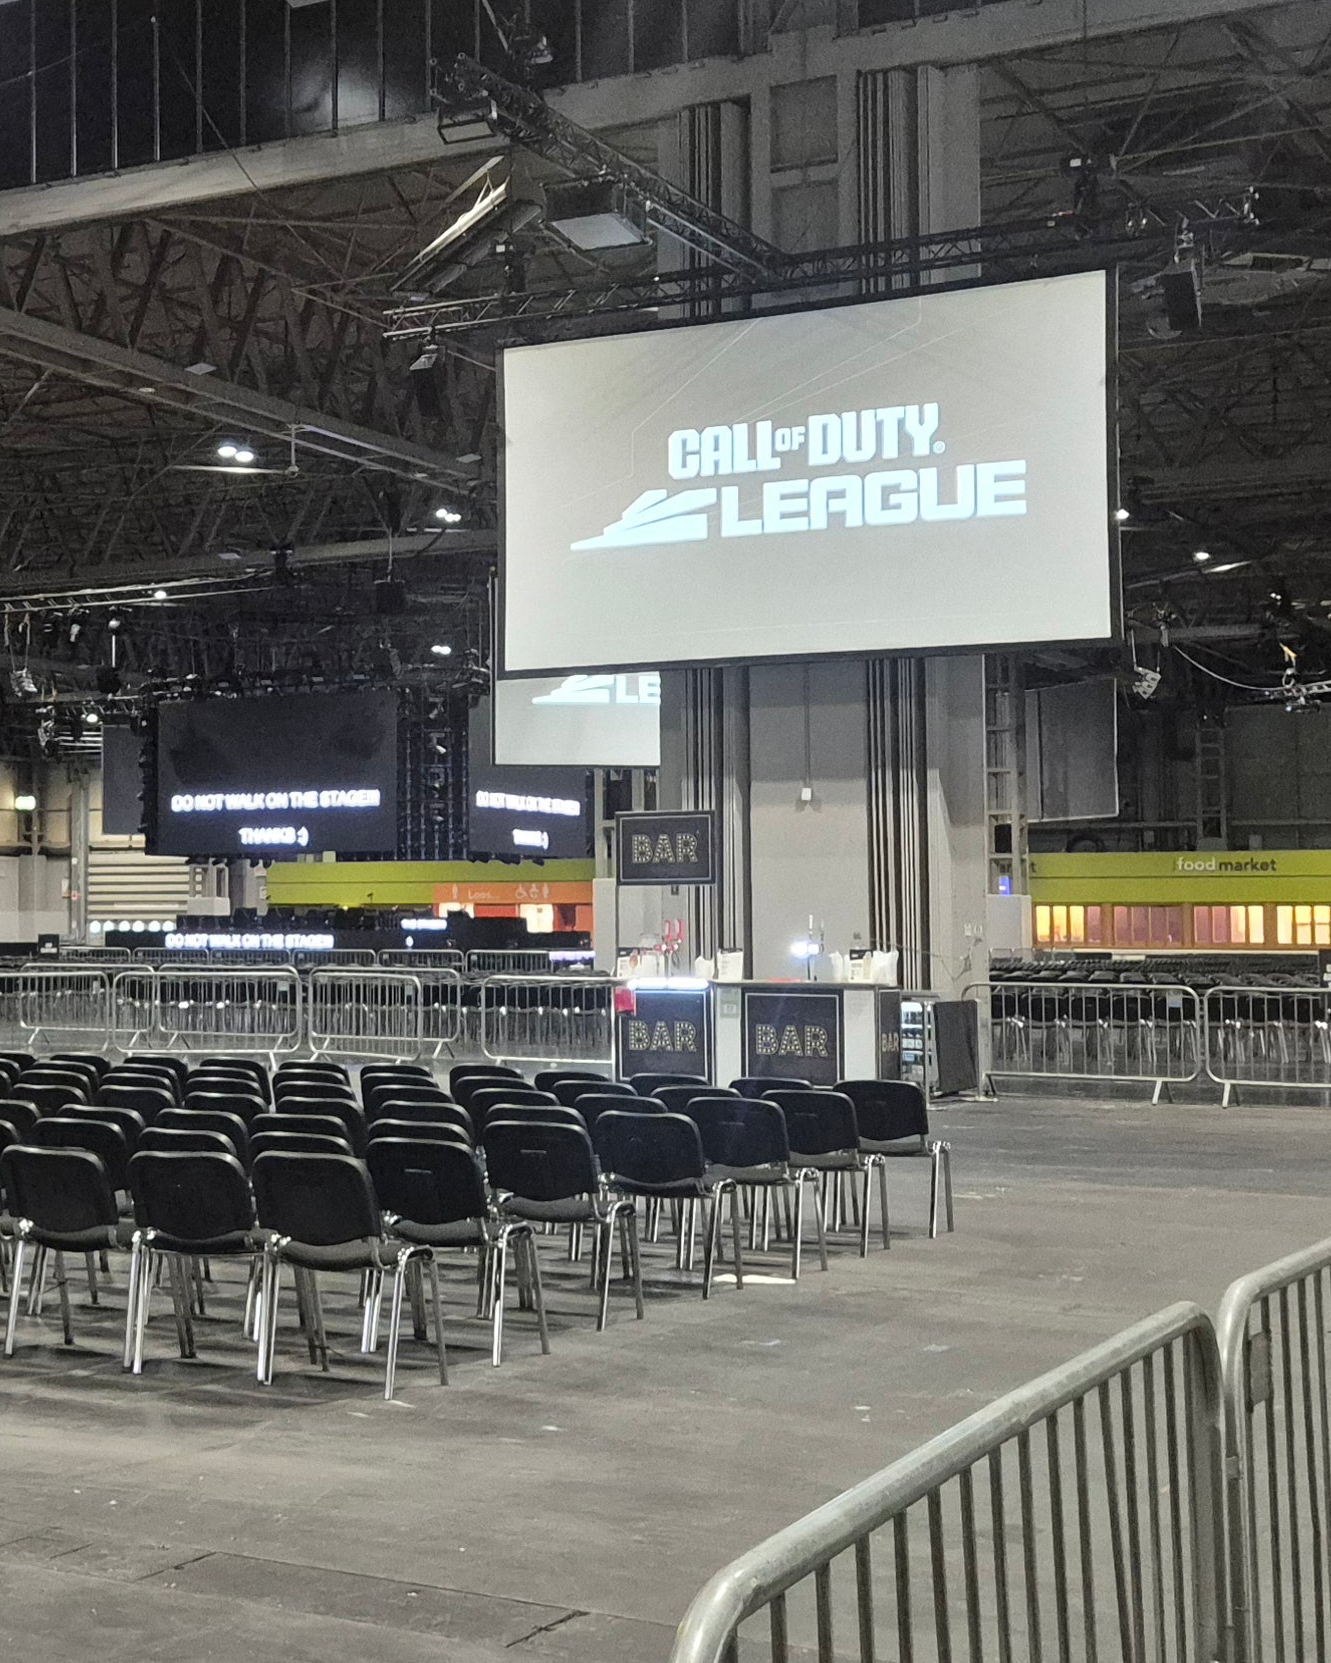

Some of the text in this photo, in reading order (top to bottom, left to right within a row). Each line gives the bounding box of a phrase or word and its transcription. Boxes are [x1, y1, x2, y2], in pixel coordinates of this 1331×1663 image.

[668, 419, 781, 480] CALL
[774, 426, 806, 452] OF
[721, 459, 1026, 538] LEAGUE
[171, 795, 194, 812] DO
[195, 794, 224, 811] NOT
[225, 793, 265, 810] WALK
[265, 792, 288, 809] ON
[289, 791, 318, 808] THE
[631, 833, 698, 864] BAR
[1177, 856, 1277, 871] food market
[629, 1020, 697, 1052] BAR
[755, 1024, 829, 1058] BAR
[882, 1031, 900, 1052] BAR
